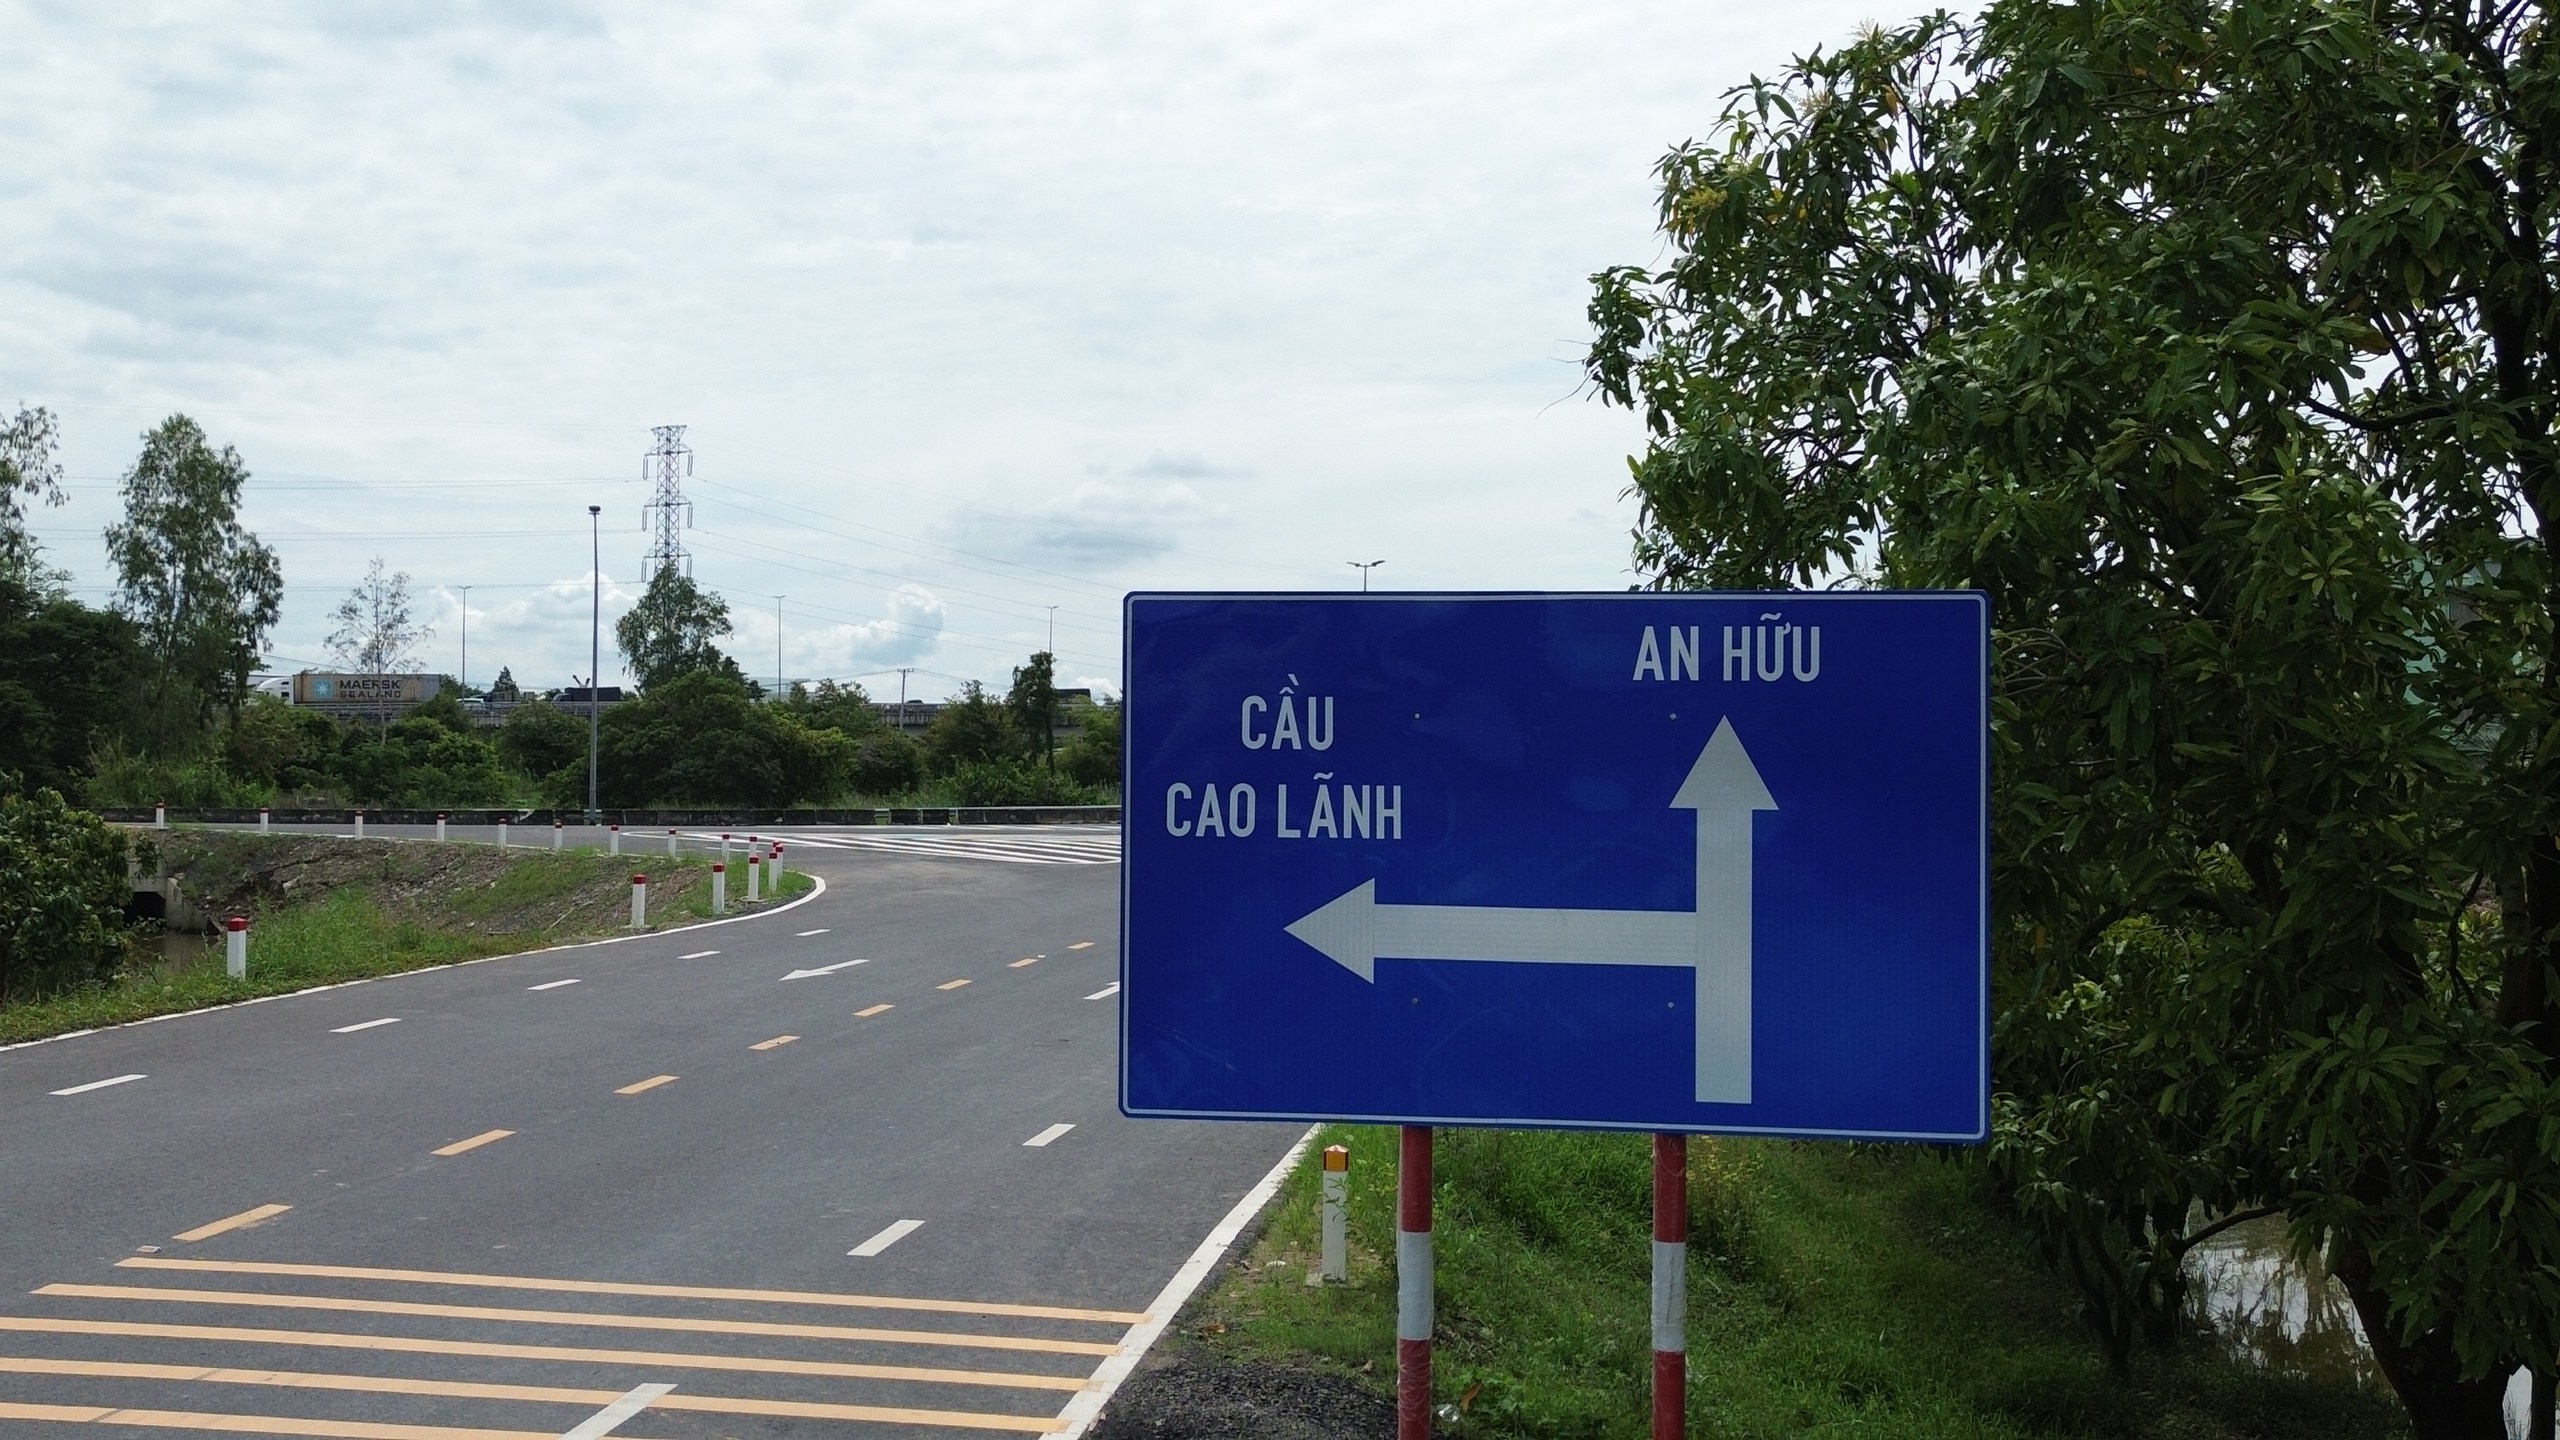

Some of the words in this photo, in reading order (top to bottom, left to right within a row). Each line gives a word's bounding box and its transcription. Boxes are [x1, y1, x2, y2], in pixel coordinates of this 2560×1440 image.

[1633, 626, 1698, 681] AN
[1723, 612, 1820, 682] HỮU
[340, 680, 401, 690] MAERSK
[1241, 673, 1334, 751] CẦU
[1166, 782, 1256, 838] CAO
[1277, 772, 1402, 840] LÃNH
